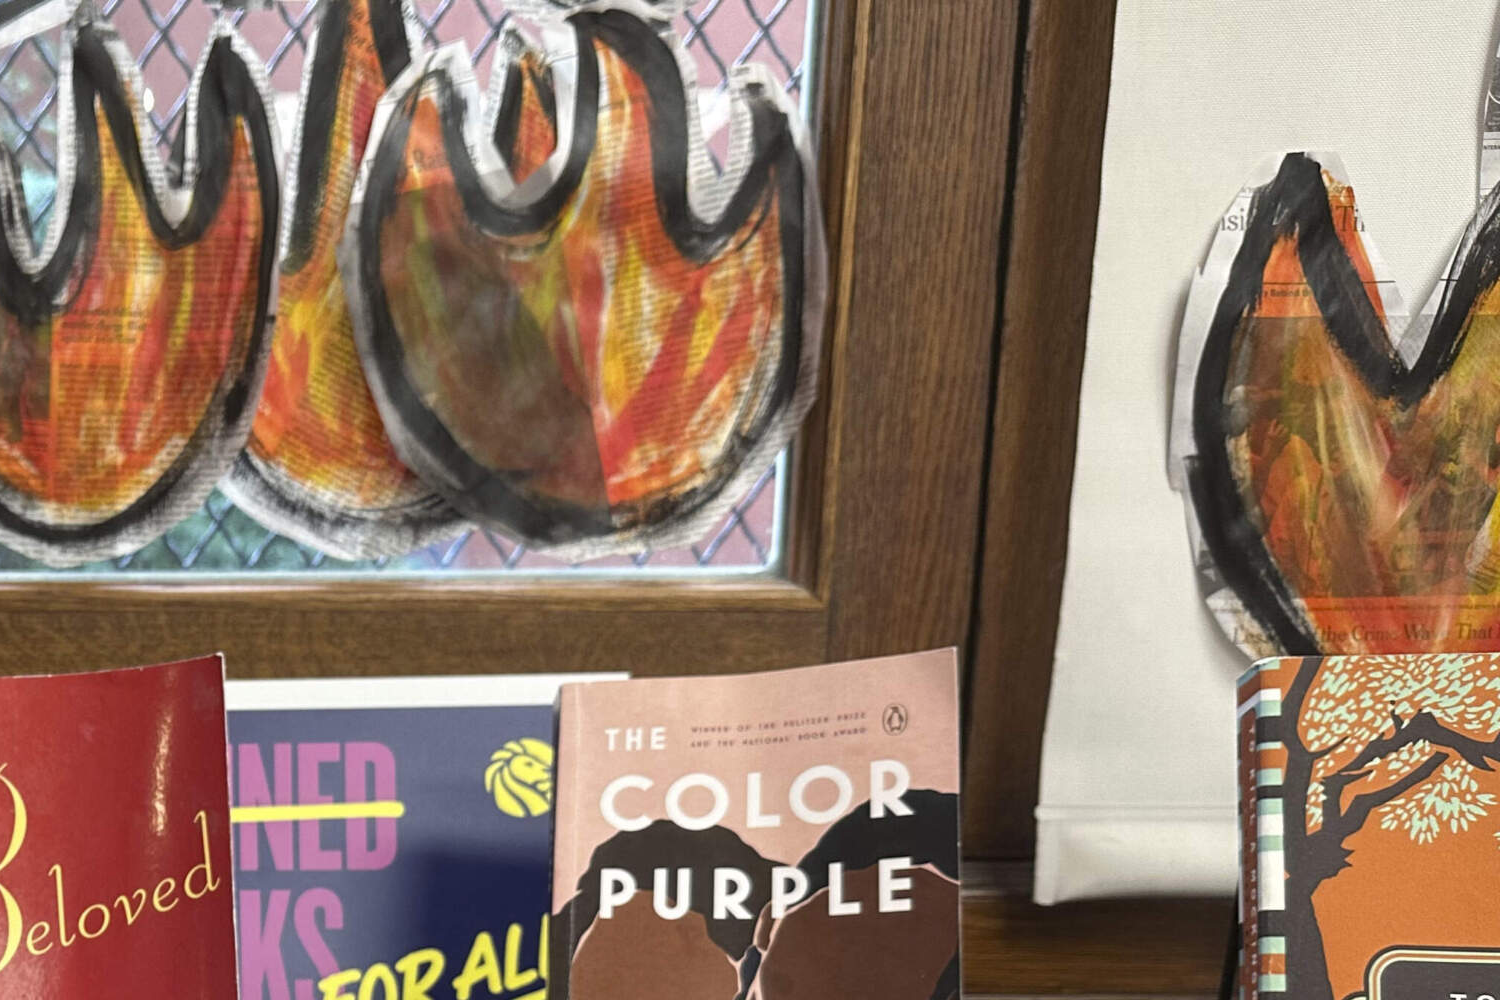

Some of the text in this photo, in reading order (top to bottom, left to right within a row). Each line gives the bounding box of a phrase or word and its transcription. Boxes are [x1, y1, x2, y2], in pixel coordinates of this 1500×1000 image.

[605, 726, 667, 752] THE
[600, 759, 915, 832] COLOR
[599, 857, 914, 921] PURPLE
